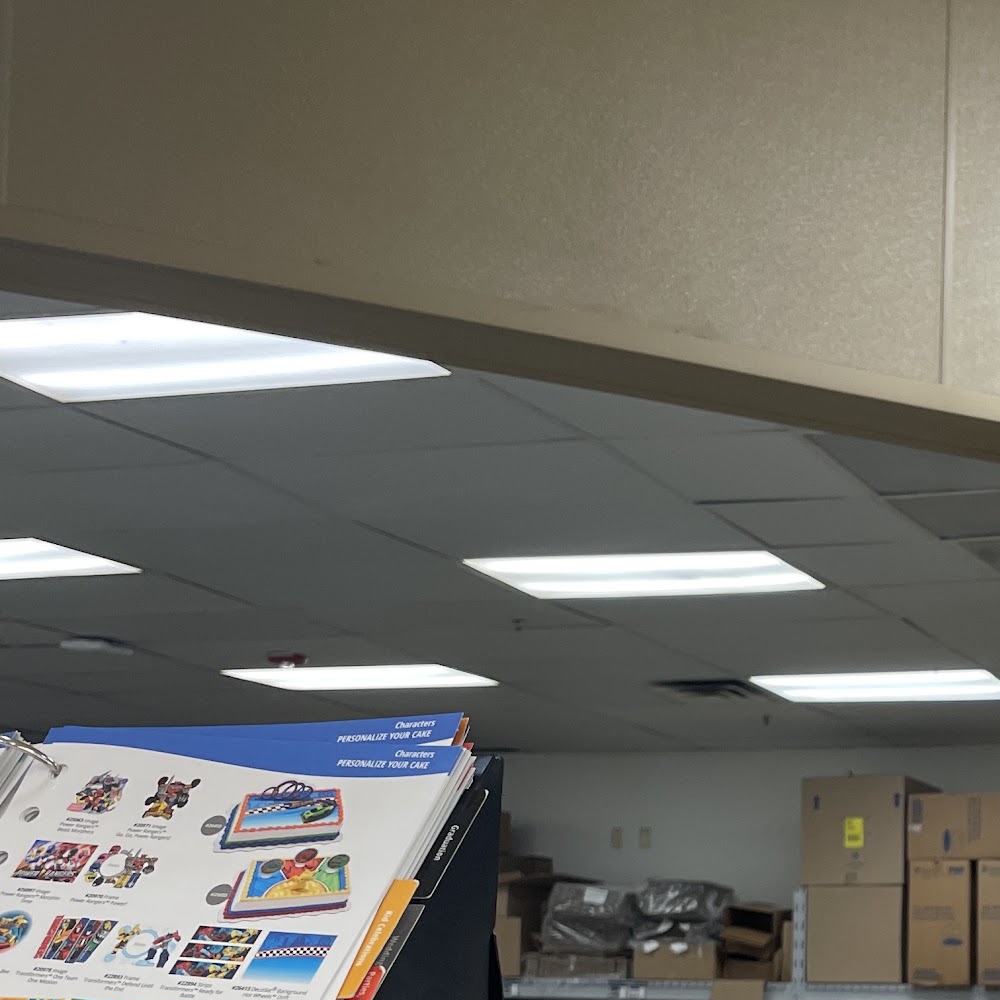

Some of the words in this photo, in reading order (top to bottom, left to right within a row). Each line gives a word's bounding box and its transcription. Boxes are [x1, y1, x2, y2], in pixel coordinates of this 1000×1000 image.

[395, 719, 436, 730] Characters
[337, 731, 387, 743] PERSONALIZE
[389, 731, 409, 741] YOUR
[411, 730, 432, 740] CAKE
[394, 750, 435, 759] Characters
[336, 759, 386, 769] PERSONALIZE
[387, 760, 409, 770] YOUR
[410, 761, 430, 770] CAKE
[434, 824, 460, 862] Graduation
[384, 910, 394, 923] Kid
[355, 922, 386, 967] Celebrations
